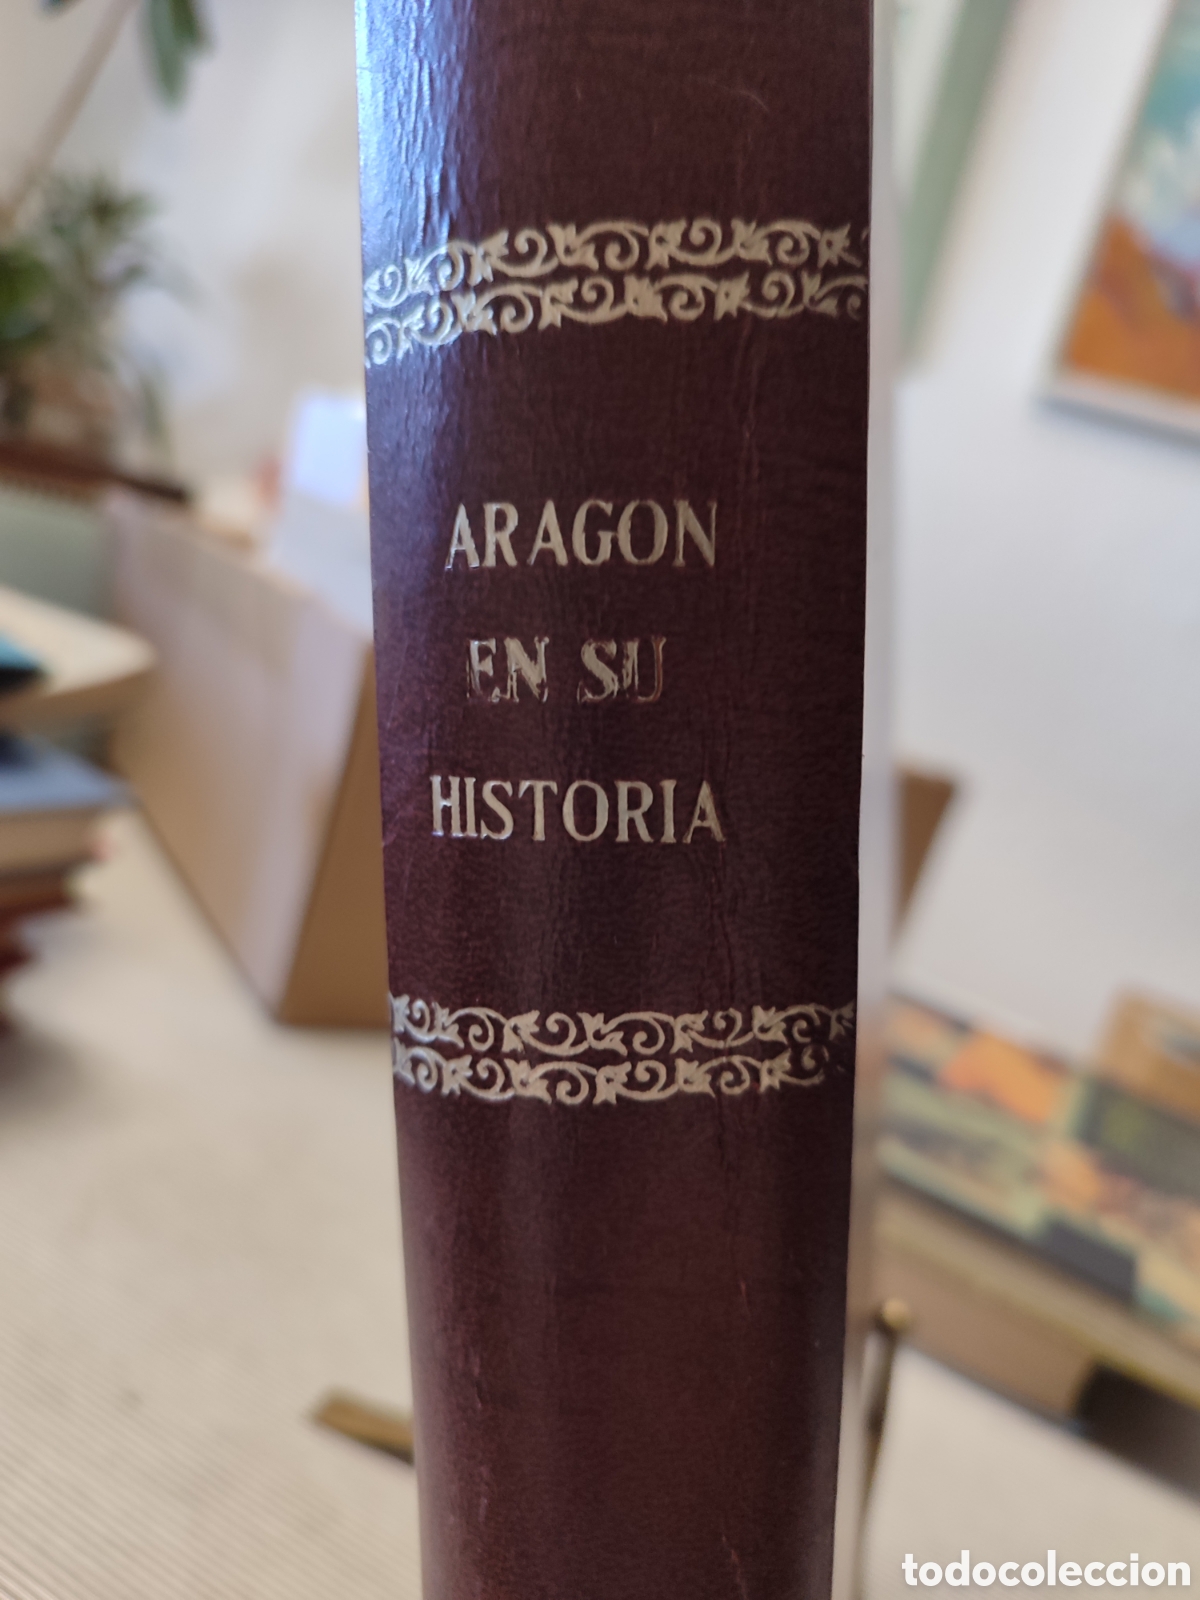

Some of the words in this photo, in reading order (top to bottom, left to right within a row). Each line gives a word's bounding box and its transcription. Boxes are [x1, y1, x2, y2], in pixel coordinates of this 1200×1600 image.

[445, 499, 718, 571] ARAGON
[467, 636, 549, 703] EN
[577, 636, 667, 704] SU
[430, 774, 727, 844] HISTORIA
